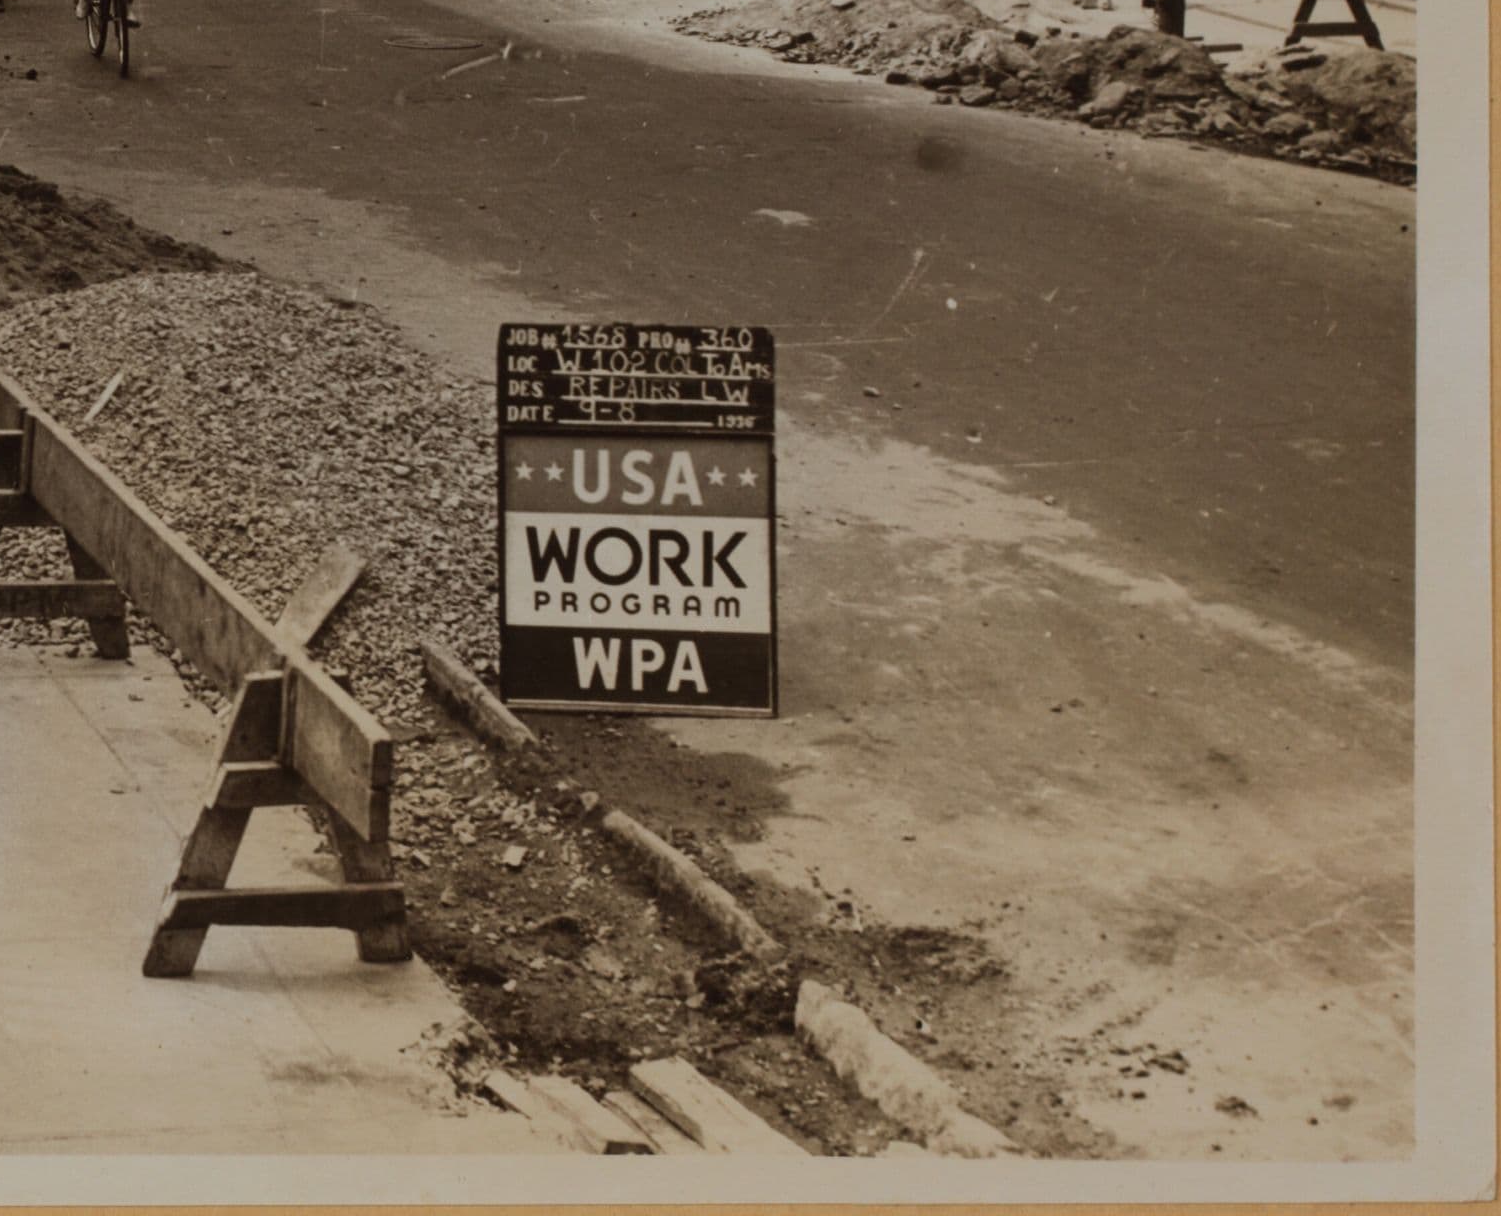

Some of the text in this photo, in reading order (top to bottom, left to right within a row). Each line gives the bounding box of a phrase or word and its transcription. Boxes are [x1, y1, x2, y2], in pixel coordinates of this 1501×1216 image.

[562, 325, 627, 348] 1568
[701, 327, 754, 349] 360
[508, 355, 538, 373] LOC
[592, 349, 646, 374] 102
[508, 380, 543, 398] DES
[507, 405, 554, 423] DATE
[573, 449, 703, 506] USA
[525, 526, 748, 588] WORK
[533, 591, 741, 618] PROGRAM
[572, 636, 709, 693] WPA
